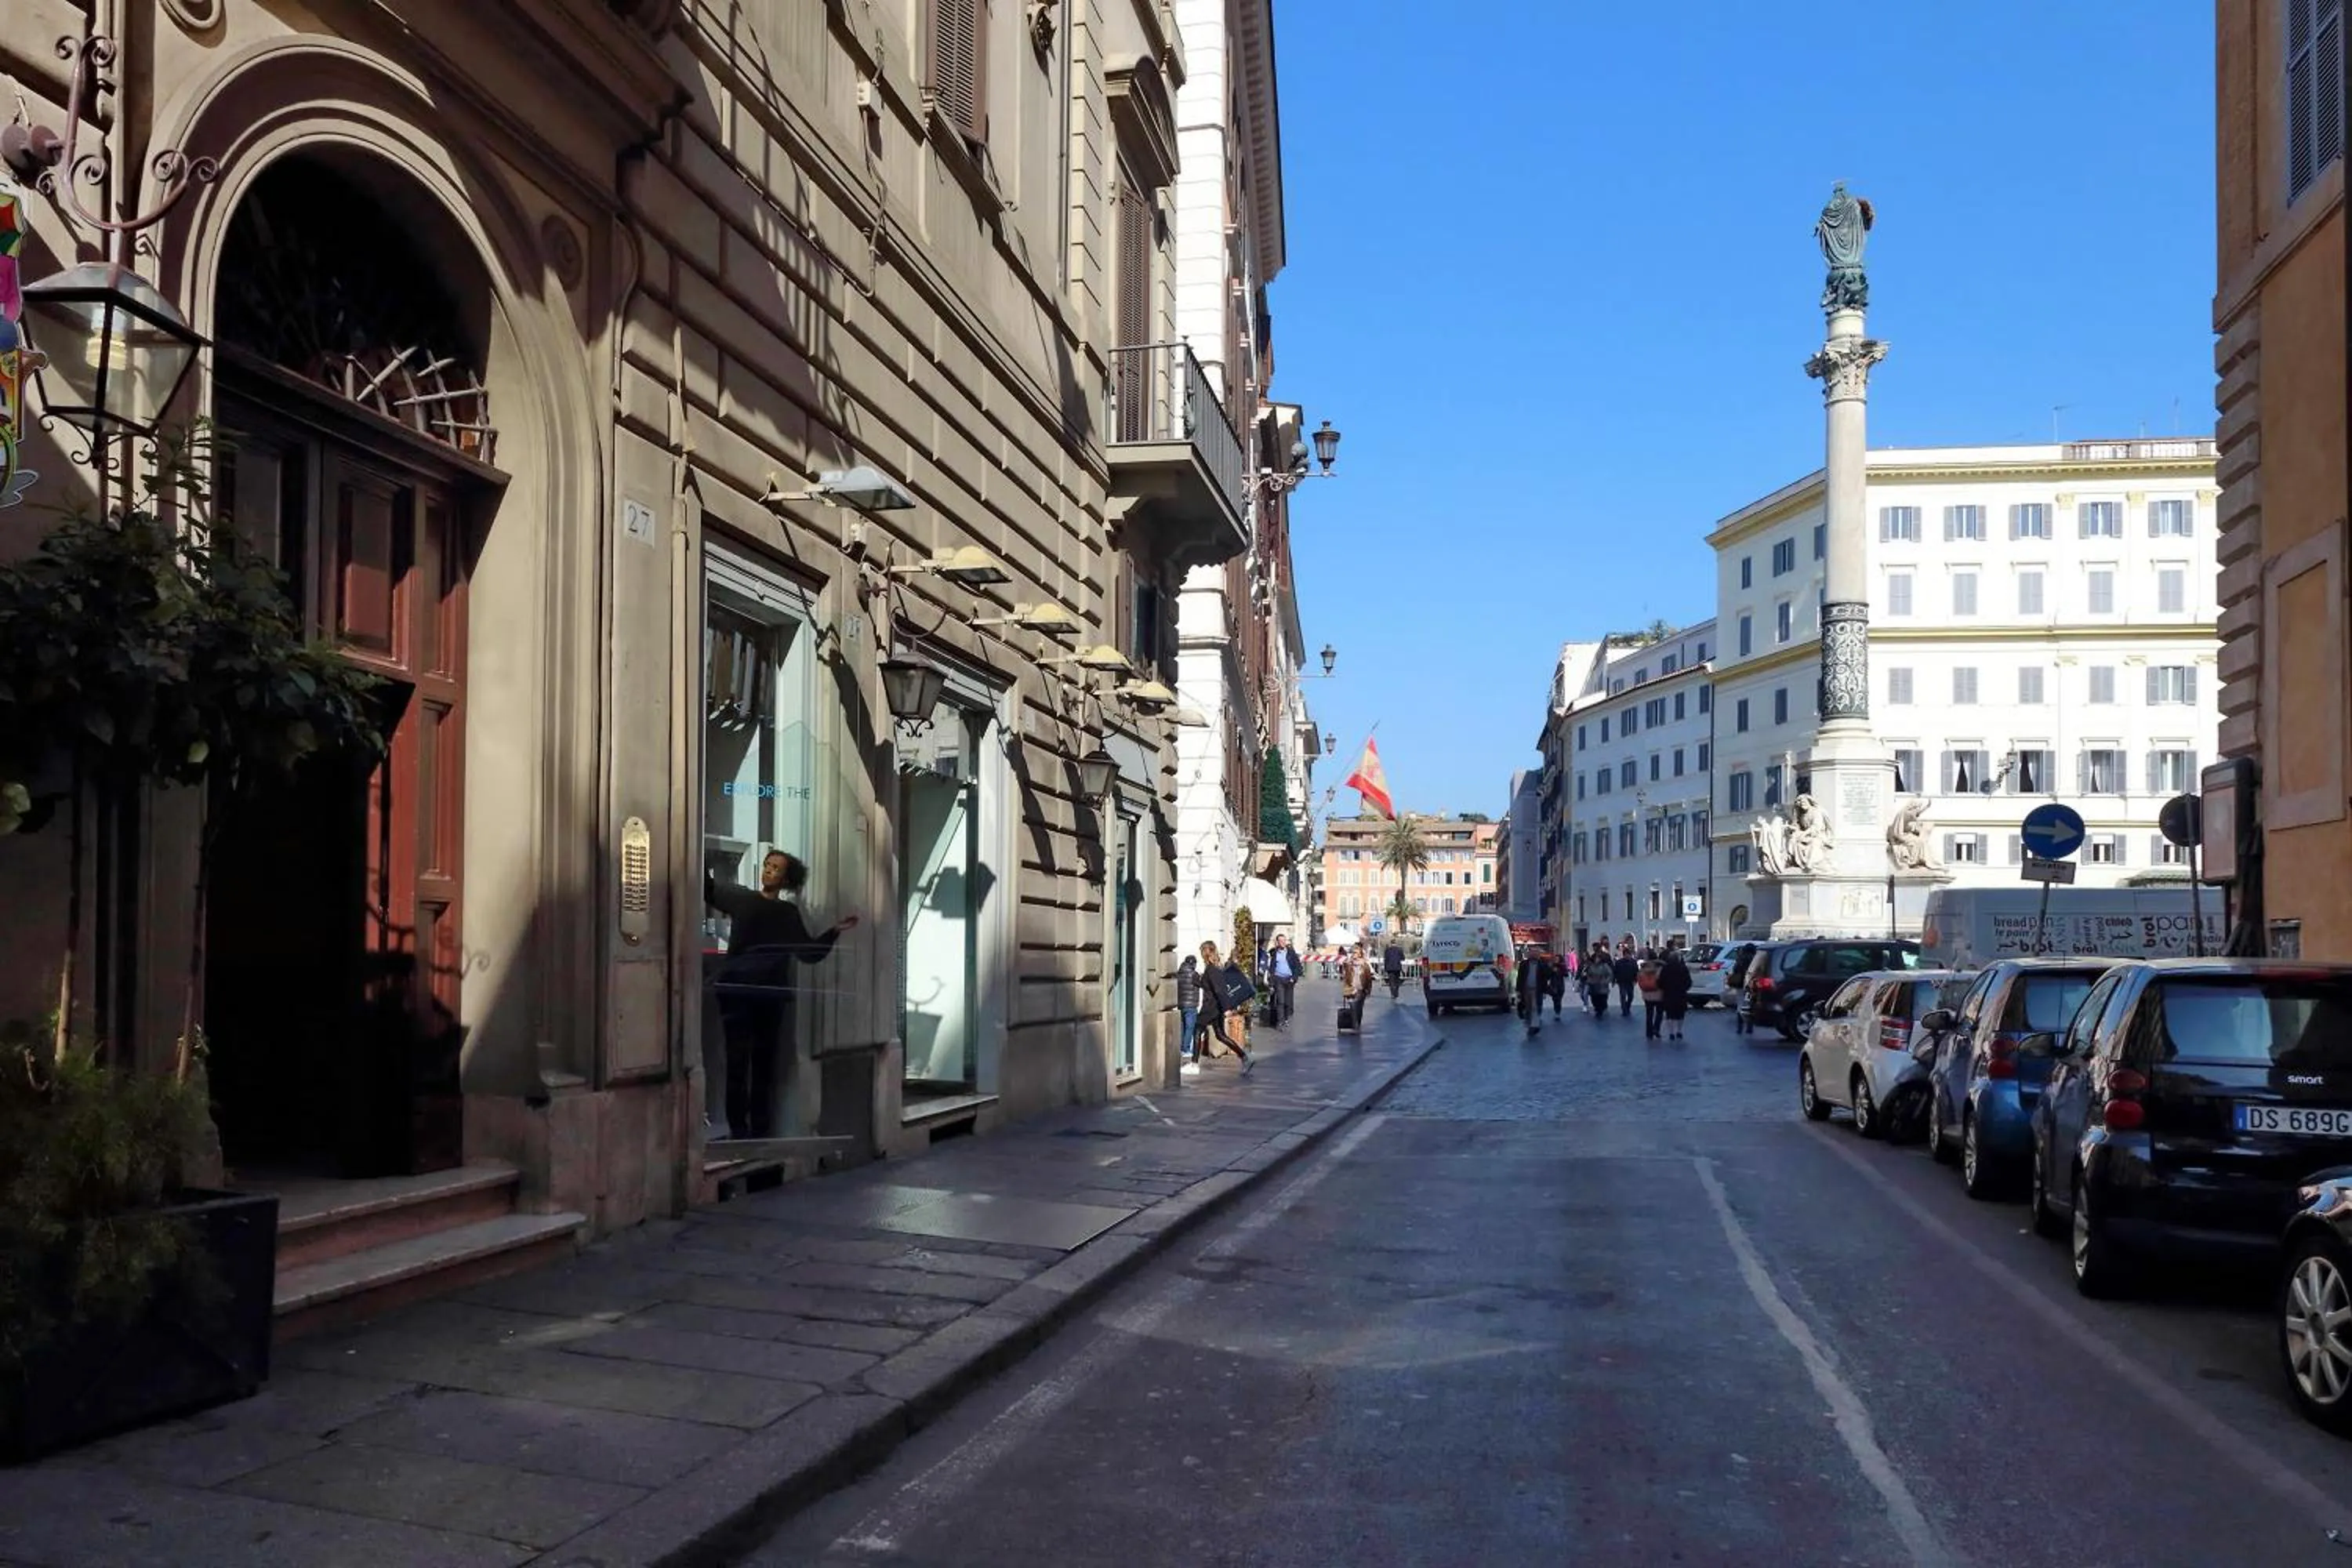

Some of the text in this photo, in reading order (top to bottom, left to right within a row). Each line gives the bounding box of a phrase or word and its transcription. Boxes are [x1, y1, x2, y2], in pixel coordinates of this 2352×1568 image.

[627, 503, 651, 538] 27
[786, 786, 811, 800] THE
[1993, 915, 2027, 927] bread
[2287, 1074, 2325, 1084] smart
[2249, 1108, 2279, 1130] DS
[2289, 1110, 2350, 1134] 689G
